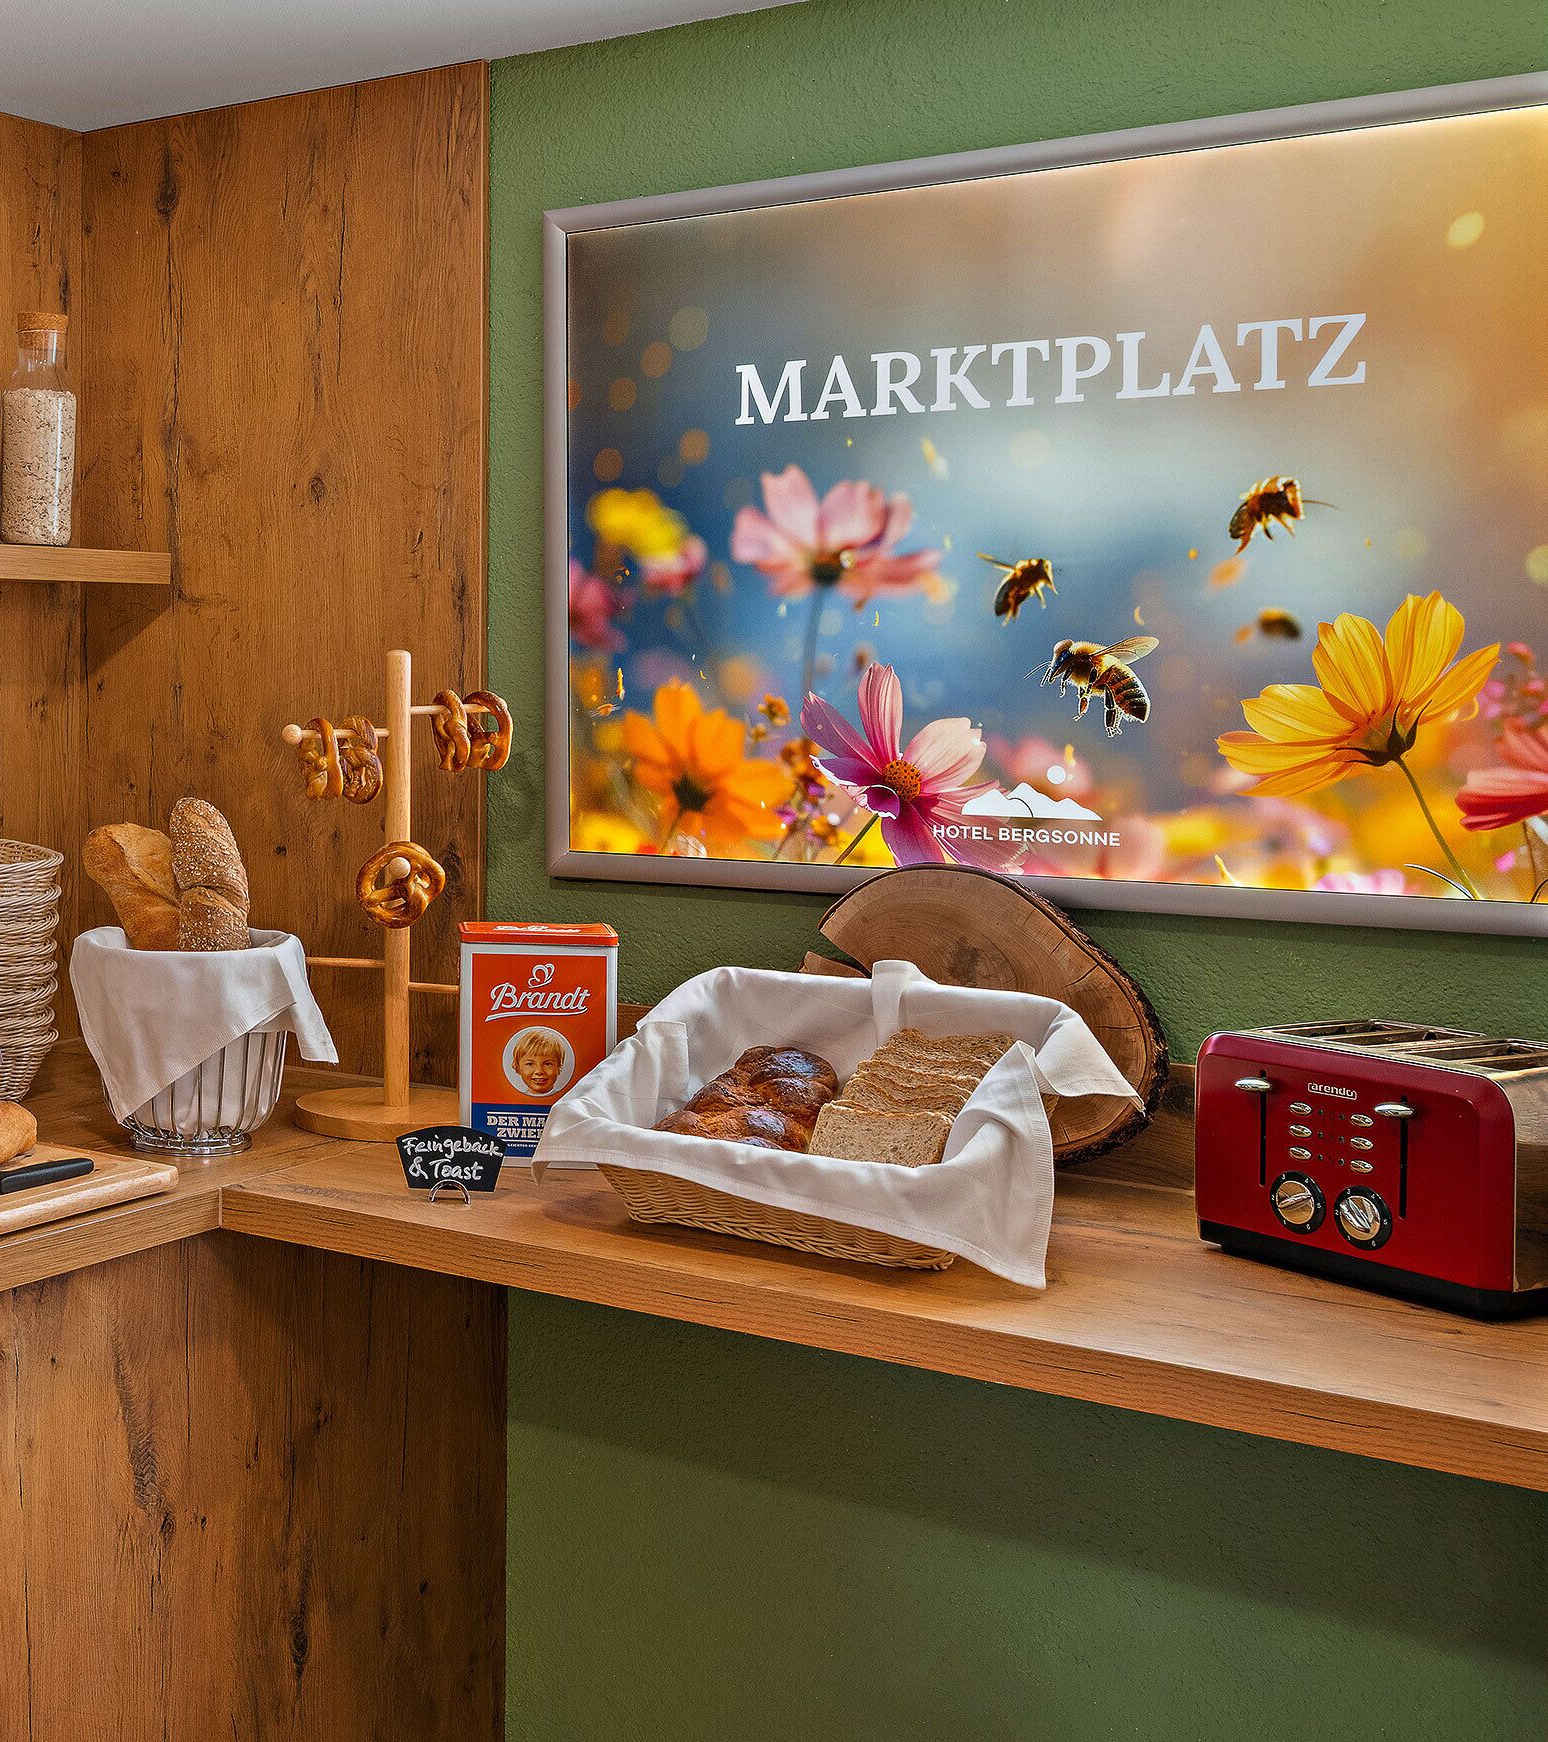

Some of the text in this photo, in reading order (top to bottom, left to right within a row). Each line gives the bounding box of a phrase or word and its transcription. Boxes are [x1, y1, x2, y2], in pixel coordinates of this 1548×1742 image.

[735, 313, 1367, 425] MARKTPLATZ
[932, 825, 1121, 847] HOTEL BERGSONNE
[490, 983, 591, 1011] Brandt
[1311, 1082, 1354, 1097] arendo
[486, 1115, 546, 1127] DER MA
[408, 1156, 484, 1180] & Toast
